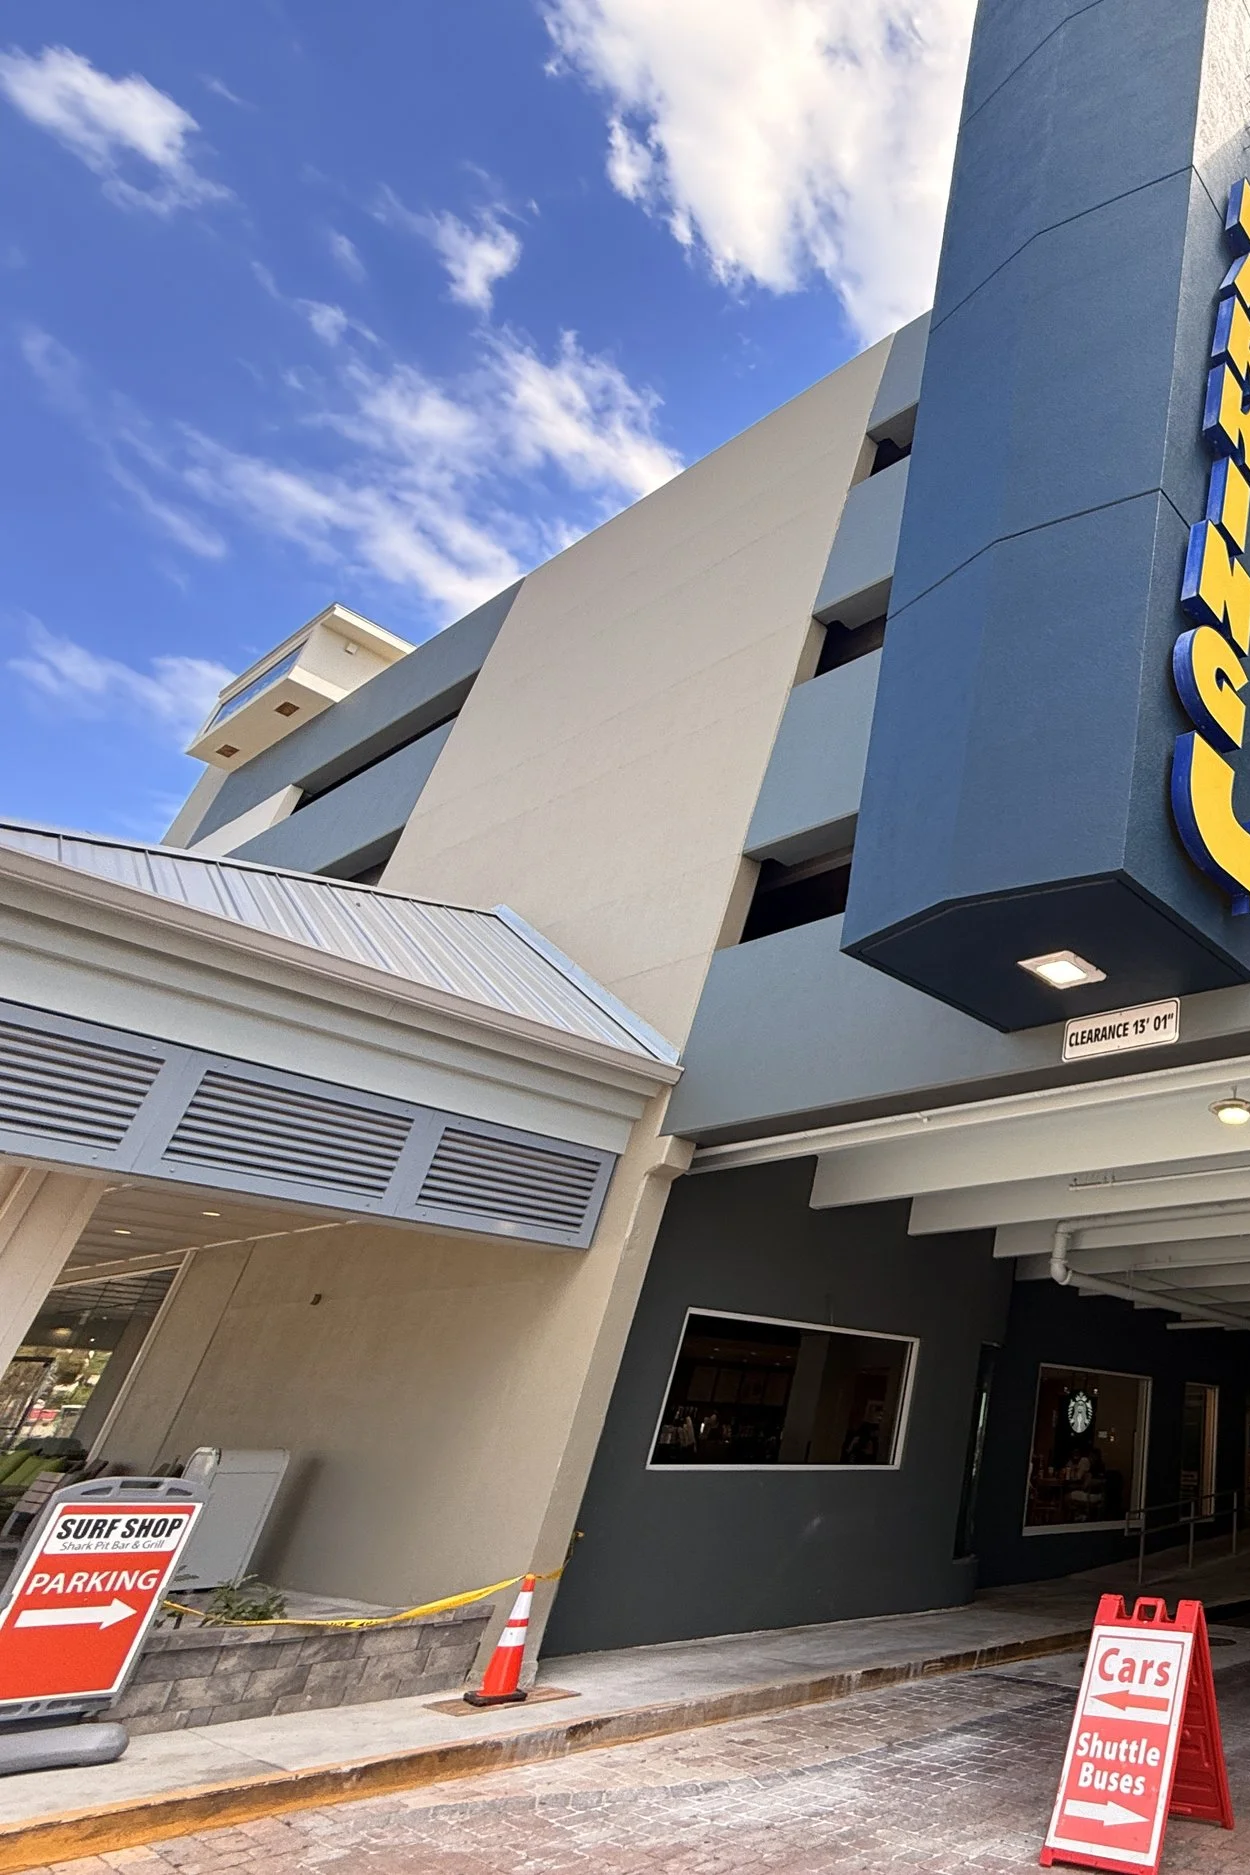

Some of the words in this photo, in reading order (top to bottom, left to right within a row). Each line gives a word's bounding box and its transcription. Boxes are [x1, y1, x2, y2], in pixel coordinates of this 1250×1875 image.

[1069, 1022, 1129, 1047] CLEARANCE
[1133, 1017, 1150, 1035] 13'
[1153, 1012, 1174, 1031] 01"
[56, 1518, 122, 1540] SURF
[121, 1517, 183, 1539] SHOP
[60, 1541, 93, 1551] Shark
[94, 1541, 111, 1550] Pit
[111, 1541, 130, 1550] Bar
[131, 1540, 140, 1549] &
[142, 1539, 166, 1549] Grill
[25, 1569, 160, 1595] PARKING
[1098, 1647, 1172, 1687] Cars
[1076, 1732, 1161, 1767] Shuttle
[1078, 1761, 1147, 1796] Buses
